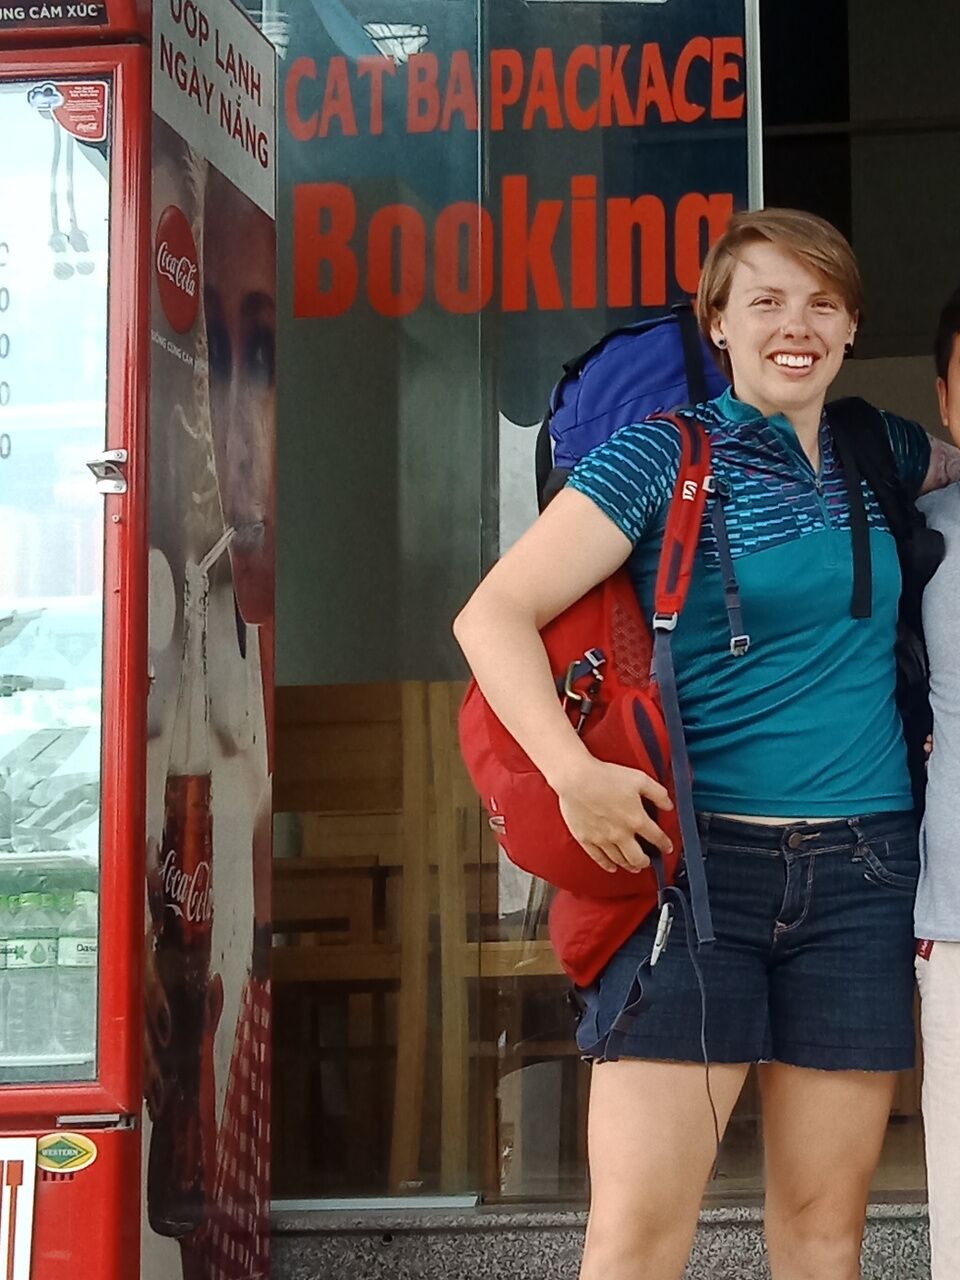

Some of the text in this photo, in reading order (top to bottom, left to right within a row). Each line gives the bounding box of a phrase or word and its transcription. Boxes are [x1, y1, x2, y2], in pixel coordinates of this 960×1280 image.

[160, 33, 214, 115] NGÀY
[215, 29, 261, 107] LẠNH
[284, 53, 397, 141] CAT
[406, 49, 480, 134] BA
[157, 241, 197, 297] Coca-Cola
[292, 174, 735, 320] Booking
